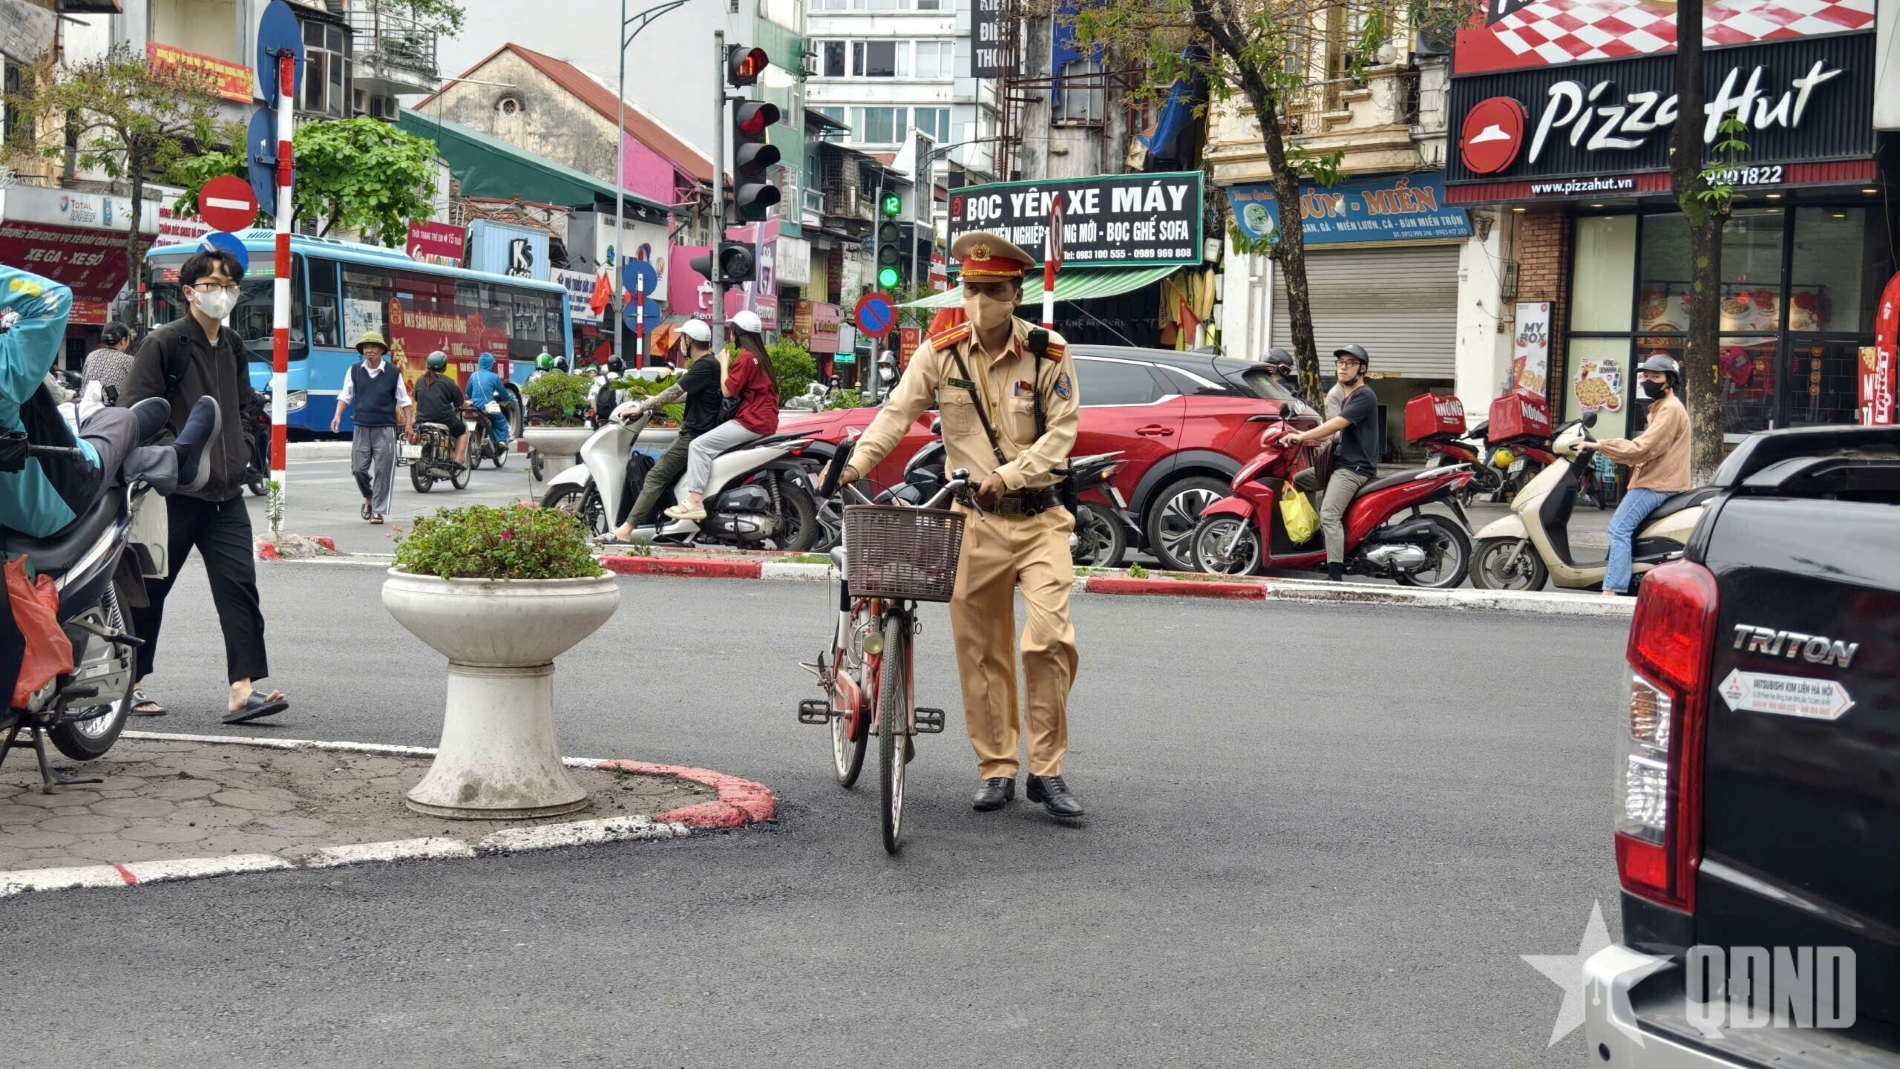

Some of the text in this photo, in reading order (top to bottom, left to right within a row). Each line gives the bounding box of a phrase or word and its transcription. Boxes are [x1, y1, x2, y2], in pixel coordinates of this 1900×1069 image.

[1704, 60, 1843, 144] Hut
[1361, 176, 1438, 216] MIẾN
[1531, 177, 1633, 196] www.pizzahut.vn
[886, 197, 898, 211] 12
[967, 180, 1188, 226] BỌC YÊN XE MÁY
[1079, 219, 1097, 242] MỚI
[1106, 221, 1130, 246] BỌC
[1133, 214, 1157, 241] GHẾ
[1159, 220, 1189, 240] SOFA
[24, 248, 106, 266] XE GA XE SỐ
[1063, 248, 1191, 260] Tel: 0983 100 555 0989 969 808
[1524, 322, 1544, 333] MY
[1520, 332, 1546, 343] BOX
[1733, 623, 1860, 669] TRITON
[1753, 678, 1834, 697] MITSUBISHI KIM LIÊN HÀ NỘI
